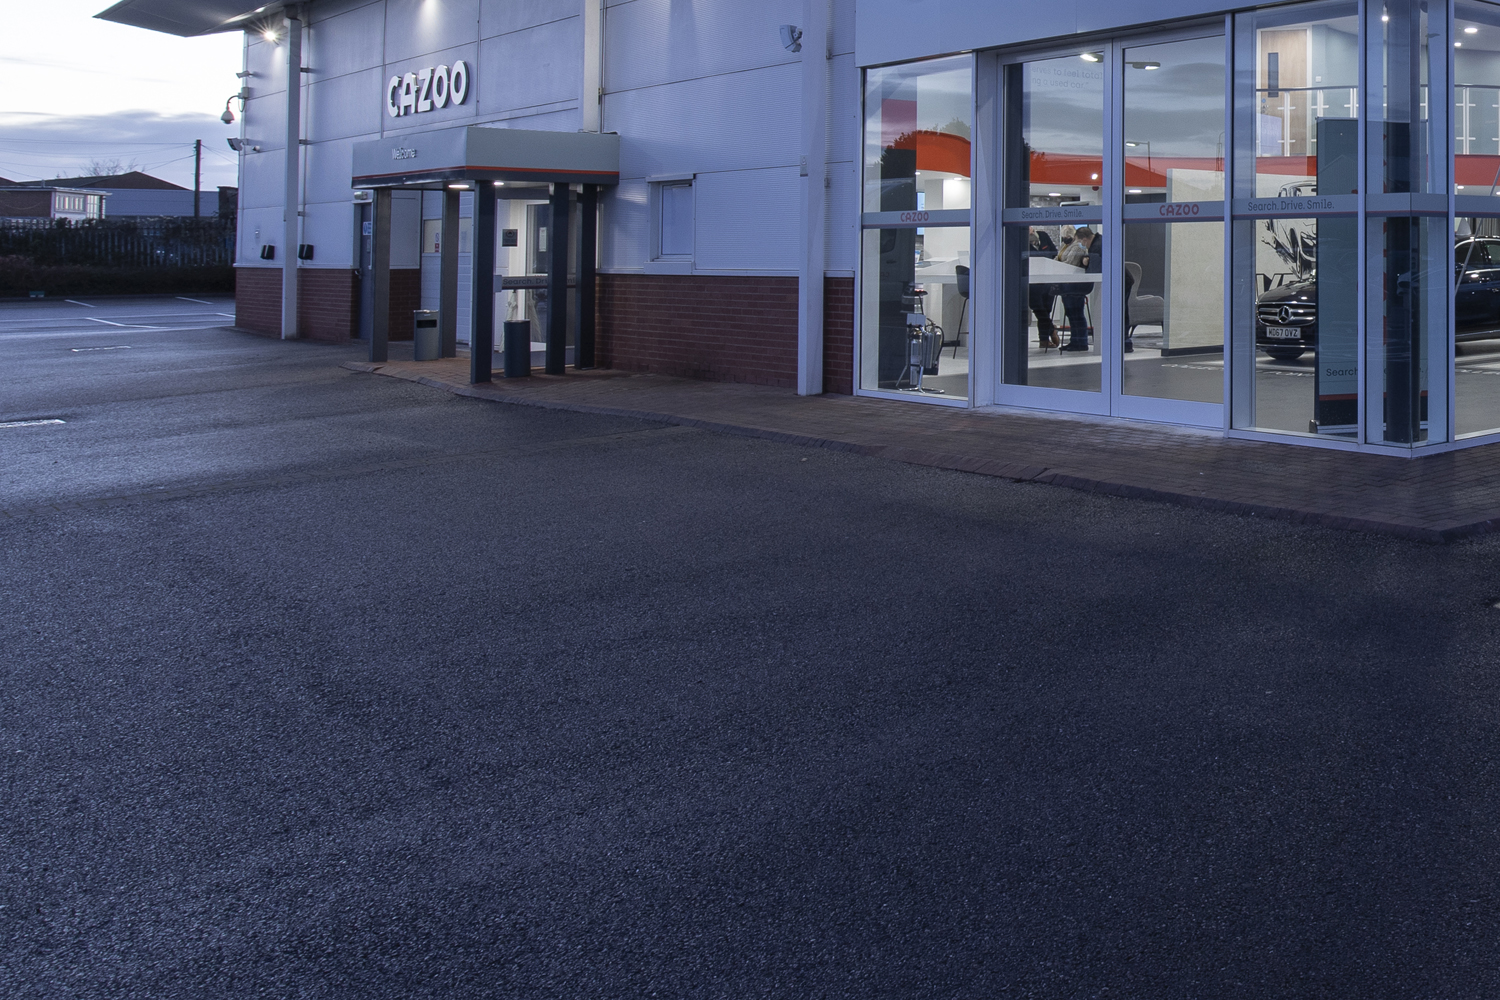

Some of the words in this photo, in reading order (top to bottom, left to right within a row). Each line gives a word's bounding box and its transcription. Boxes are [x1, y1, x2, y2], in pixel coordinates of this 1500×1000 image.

[1053, 68, 1062, 76] to
[1064, 69, 1079, 78] feel
[387, 60, 470, 117] CAZOO
[1050, 78, 1068, 88] used
[1159, 204, 1199, 216] CAZOO
[1247, 201, 1279, 212] Search.
[1280, 200, 1305, 211] Drive.
[1306, 199, 1334, 210] Smile.
[900, 211, 929, 222] CAZOO
[1021, 210, 1044, 219] Search.
[1045, 209, 1062, 218] Drive.
[1064, 208, 1084, 218] Smile.
[1285, 329, 1298, 337] OVZ
